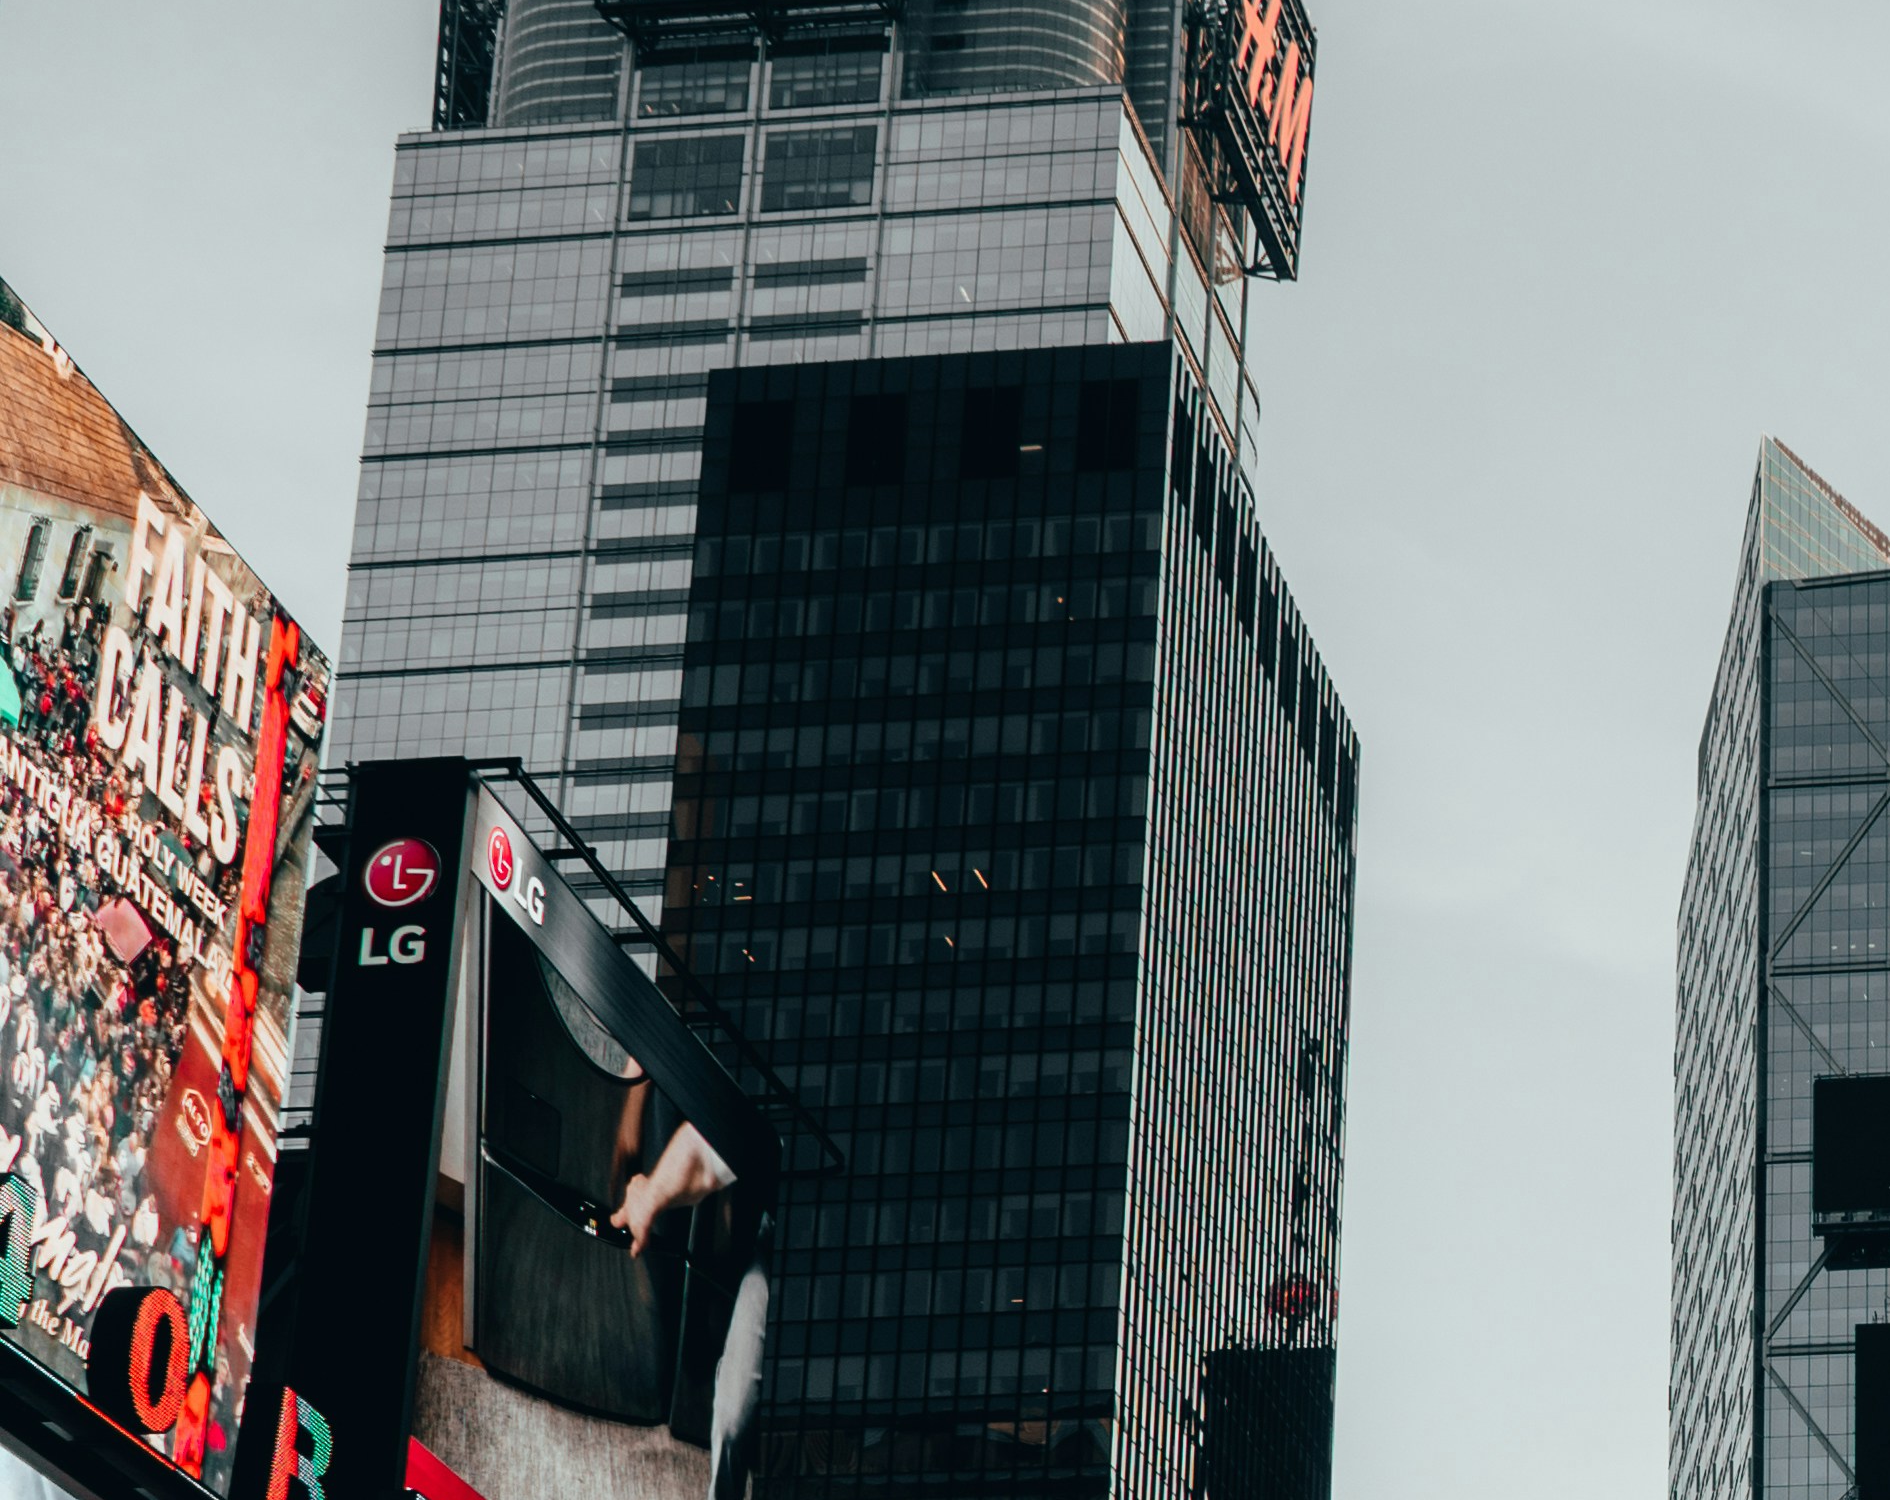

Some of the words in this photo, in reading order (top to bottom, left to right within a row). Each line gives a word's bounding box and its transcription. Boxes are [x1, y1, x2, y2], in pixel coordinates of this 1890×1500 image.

[127, 488, 262, 735] FAITH
[95, 626, 243, 865] CALLS
[126, 814, 175, 877] HOLY
[176, 860, 229, 932] WEEK
[513, 857, 547, 925] LG
[358, 925, 427, 966] LG
